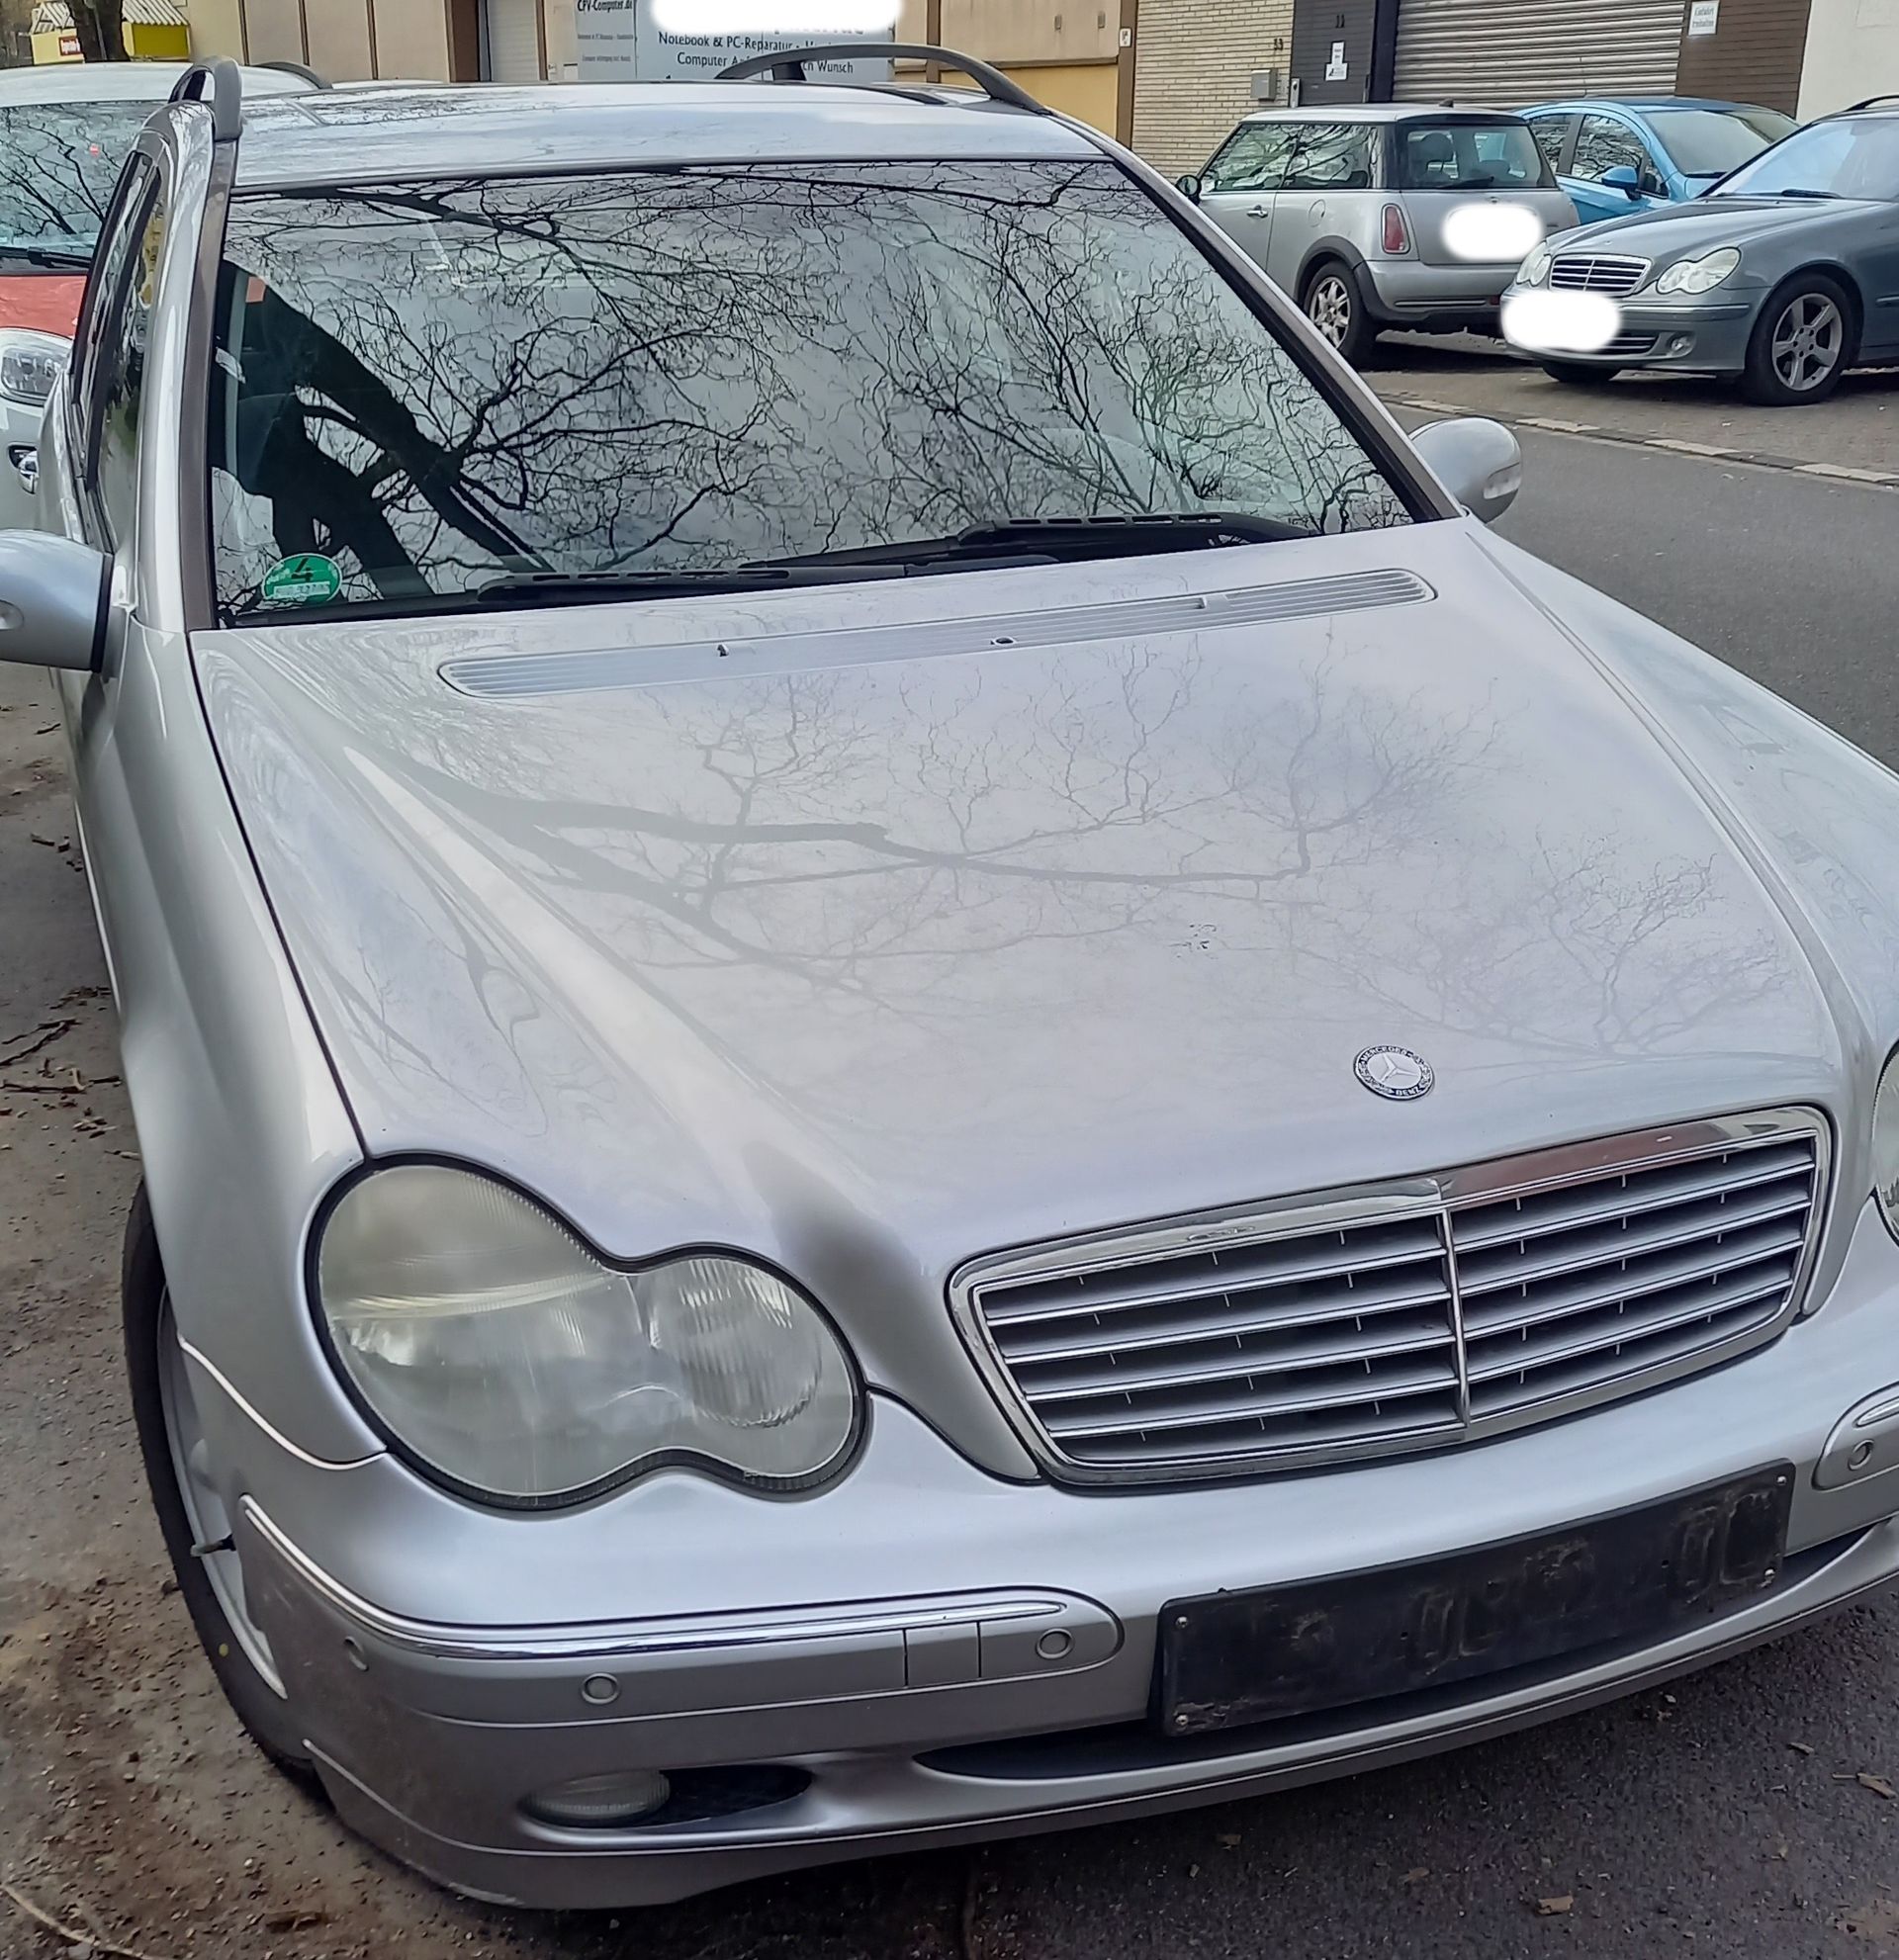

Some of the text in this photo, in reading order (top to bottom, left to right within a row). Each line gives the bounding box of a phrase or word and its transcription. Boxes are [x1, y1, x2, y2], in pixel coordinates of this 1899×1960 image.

[658, 31, 710, 46] Notebook
[713, 37, 724, 47] &
[677, 51, 728, 67] Computer
[817, 60, 854, 74] Wunsch
[291, 557, 314, 581] 4
[1396, 1086, 1422, 1097] BENZ
